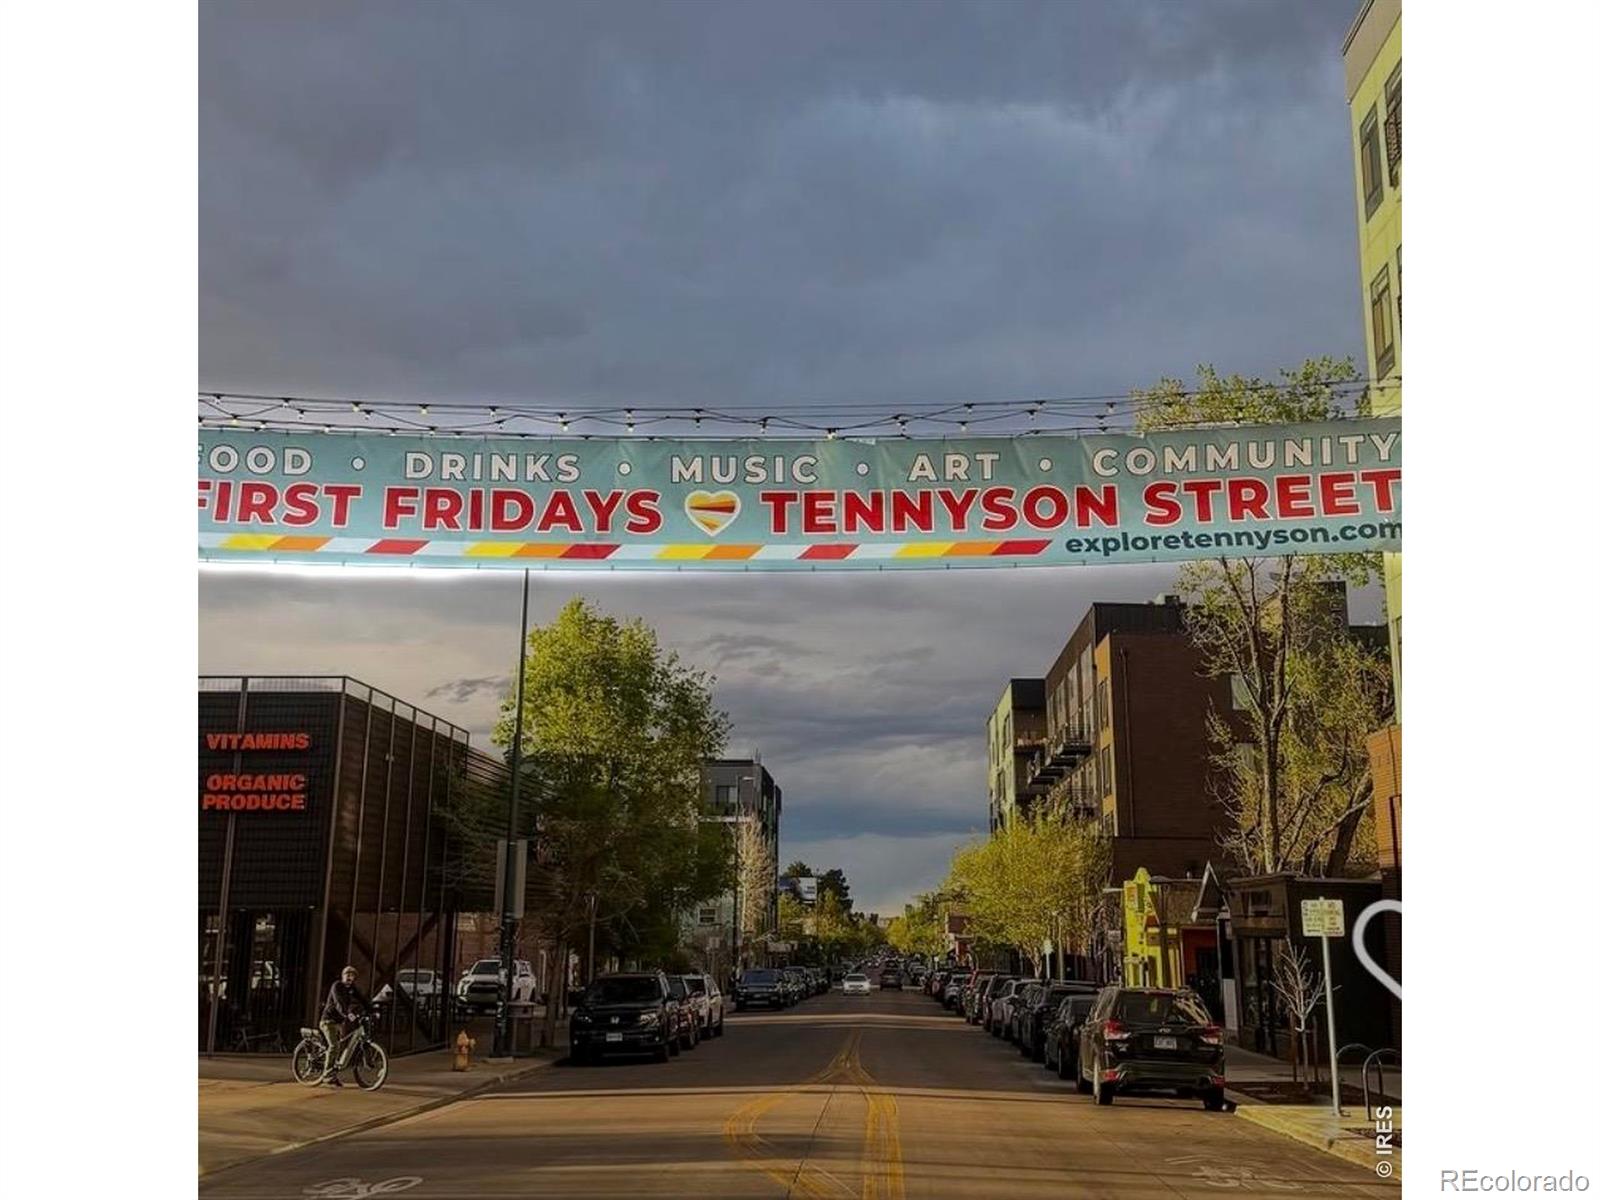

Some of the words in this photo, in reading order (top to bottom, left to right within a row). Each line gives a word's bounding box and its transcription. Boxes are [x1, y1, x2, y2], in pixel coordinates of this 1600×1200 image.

[198, 444, 312, 475] OOD
[404, 452, 581, 482] DRINKS
[670, 454, 820, 485] MUSIC
[907, 451, 1000, 483] ART
[1093, 432, 1400, 477] COMMUNITY
[383, 486, 663, 533] FRIDAYS
[760, 485, 1120, 533] TENNYSON
[1143, 468, 1402, 526] STREET
[1065, 521, 1402, 557] exploretennyson.com
[206, 733, 309, 750] VITAMINS
[206, 773, 306, 792] ORGANIC
[202, 793, 306, 811] PRODUCE
